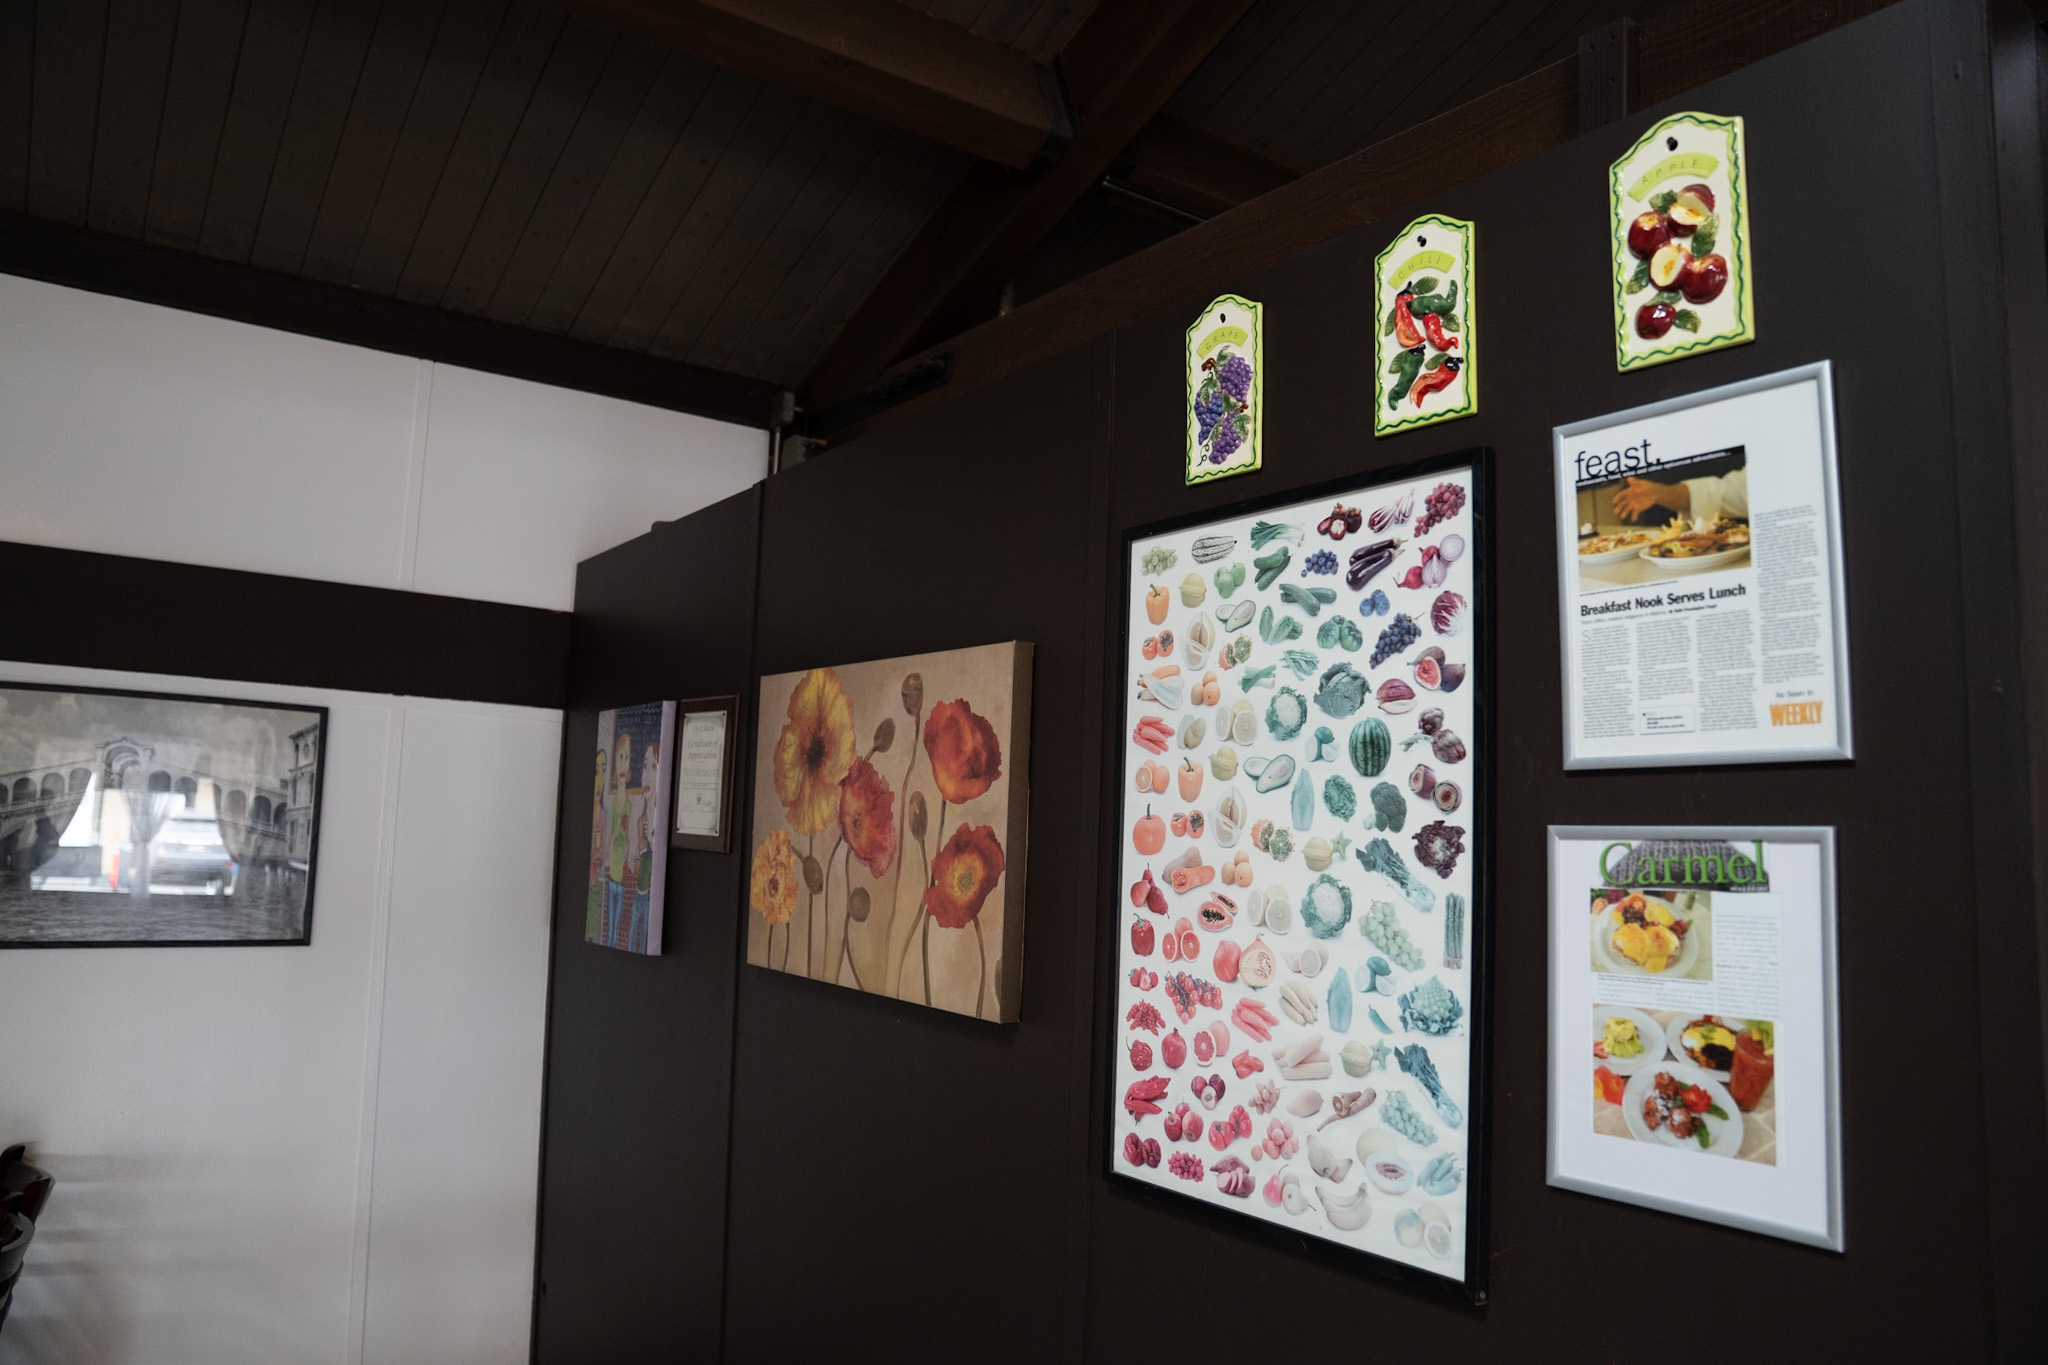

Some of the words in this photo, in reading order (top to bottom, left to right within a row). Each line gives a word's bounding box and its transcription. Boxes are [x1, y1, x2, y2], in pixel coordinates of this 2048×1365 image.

[1641, 159, 1698, 185] APPLE
[1398, 255, 1441, 280] CHILI
[1205, 330, 1239, 350] GRAPE
[1580, 599, 1631, 617] Breakfast
[1635, 594, 1664, 610] Nook
[1667, 591, 1705, 606] Serves
[1709, 583, 1746, 600] Lunch
[1769, 700, 1823, 727] WEEKLY
[1599, 840, 1768, 886] Carmel
